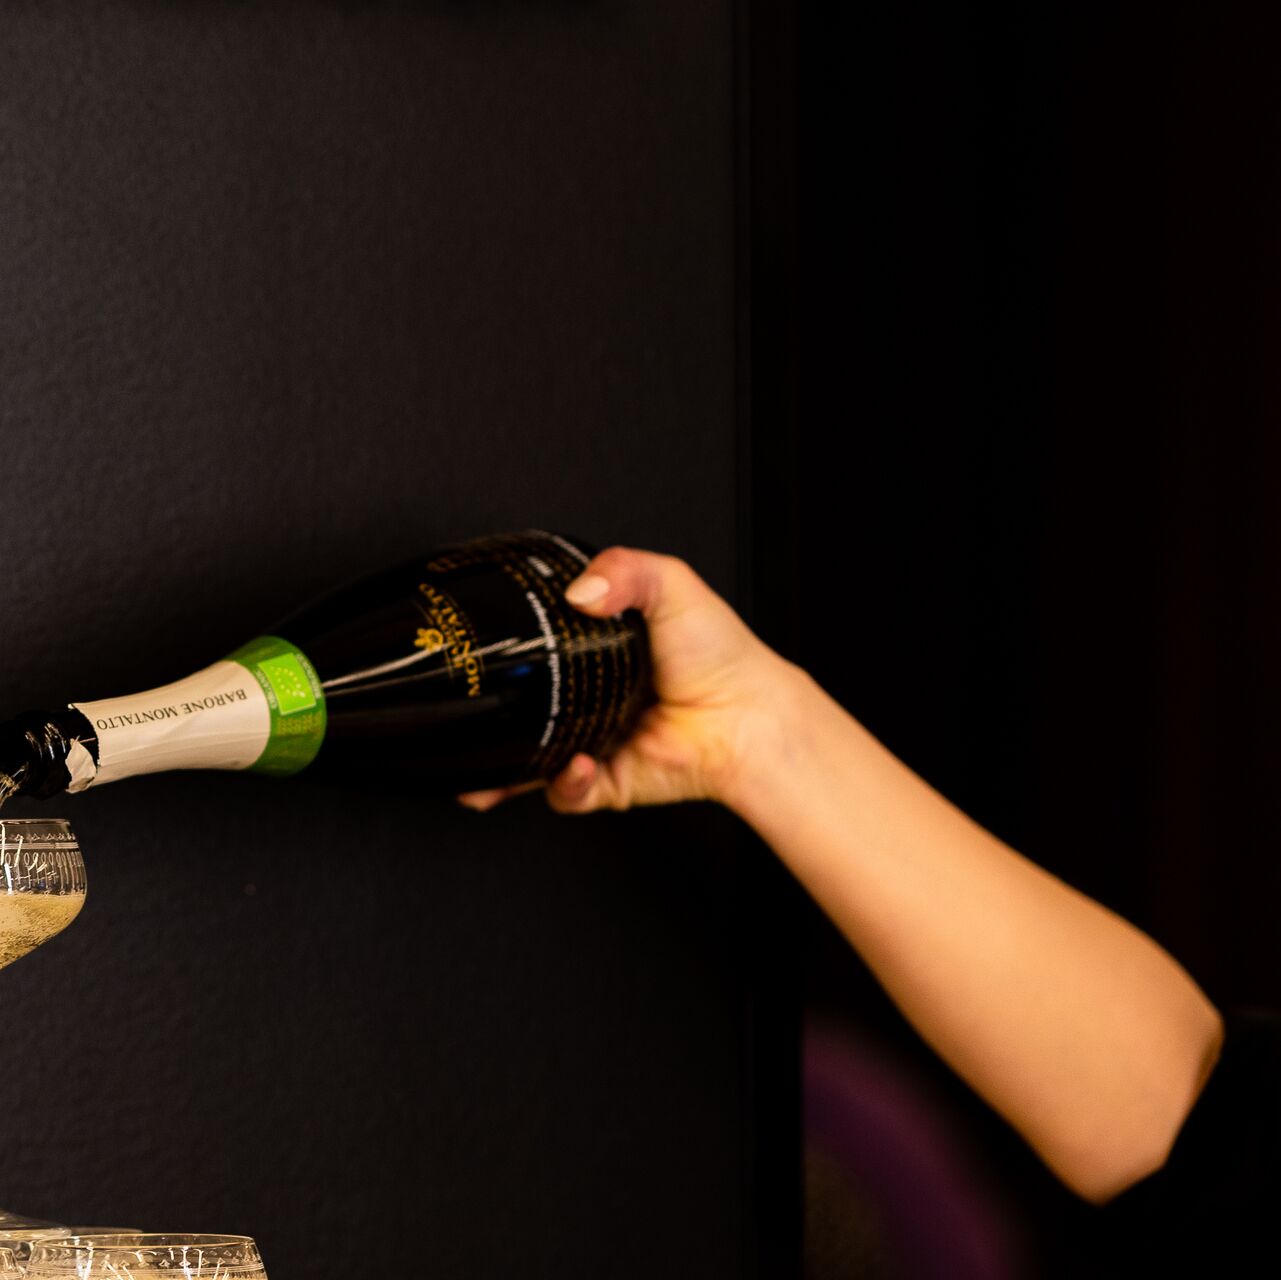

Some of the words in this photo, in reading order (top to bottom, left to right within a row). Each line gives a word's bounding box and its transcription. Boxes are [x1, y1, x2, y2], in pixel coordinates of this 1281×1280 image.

[419, 583, 480, 697] MONTALTO
[180, 688, 248, 715] BARONE
[96, 706, 179, 730] MONTALTO
